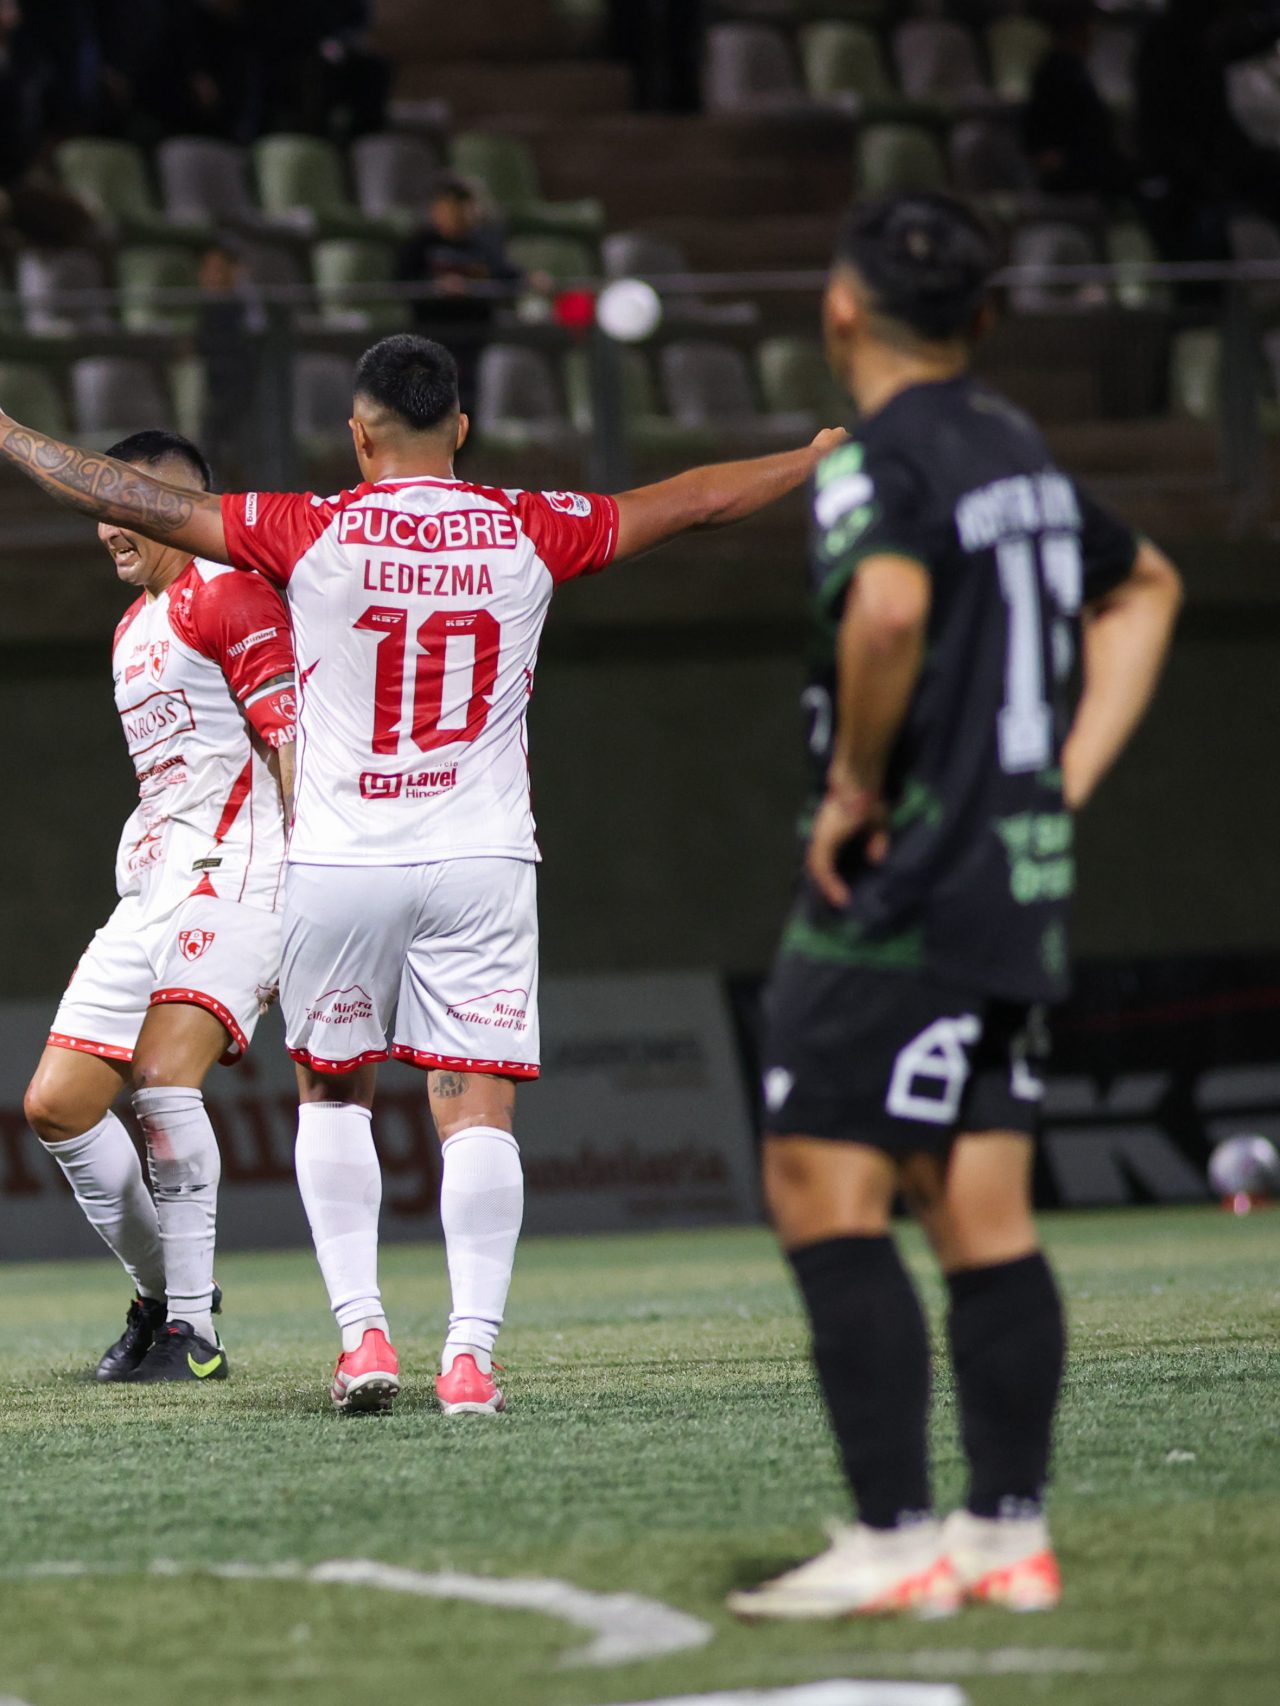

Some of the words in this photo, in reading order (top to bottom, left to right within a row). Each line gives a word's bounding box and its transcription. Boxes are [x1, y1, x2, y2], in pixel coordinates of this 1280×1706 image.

[340, 511, 517, 549] PUCOBRE
[363, 559, 493, 596] LEDEZMA
[353, 605, 501, 755] 10
[406, 767, 457, 787] Lavel
[494, 1017, 514, 1030] del
